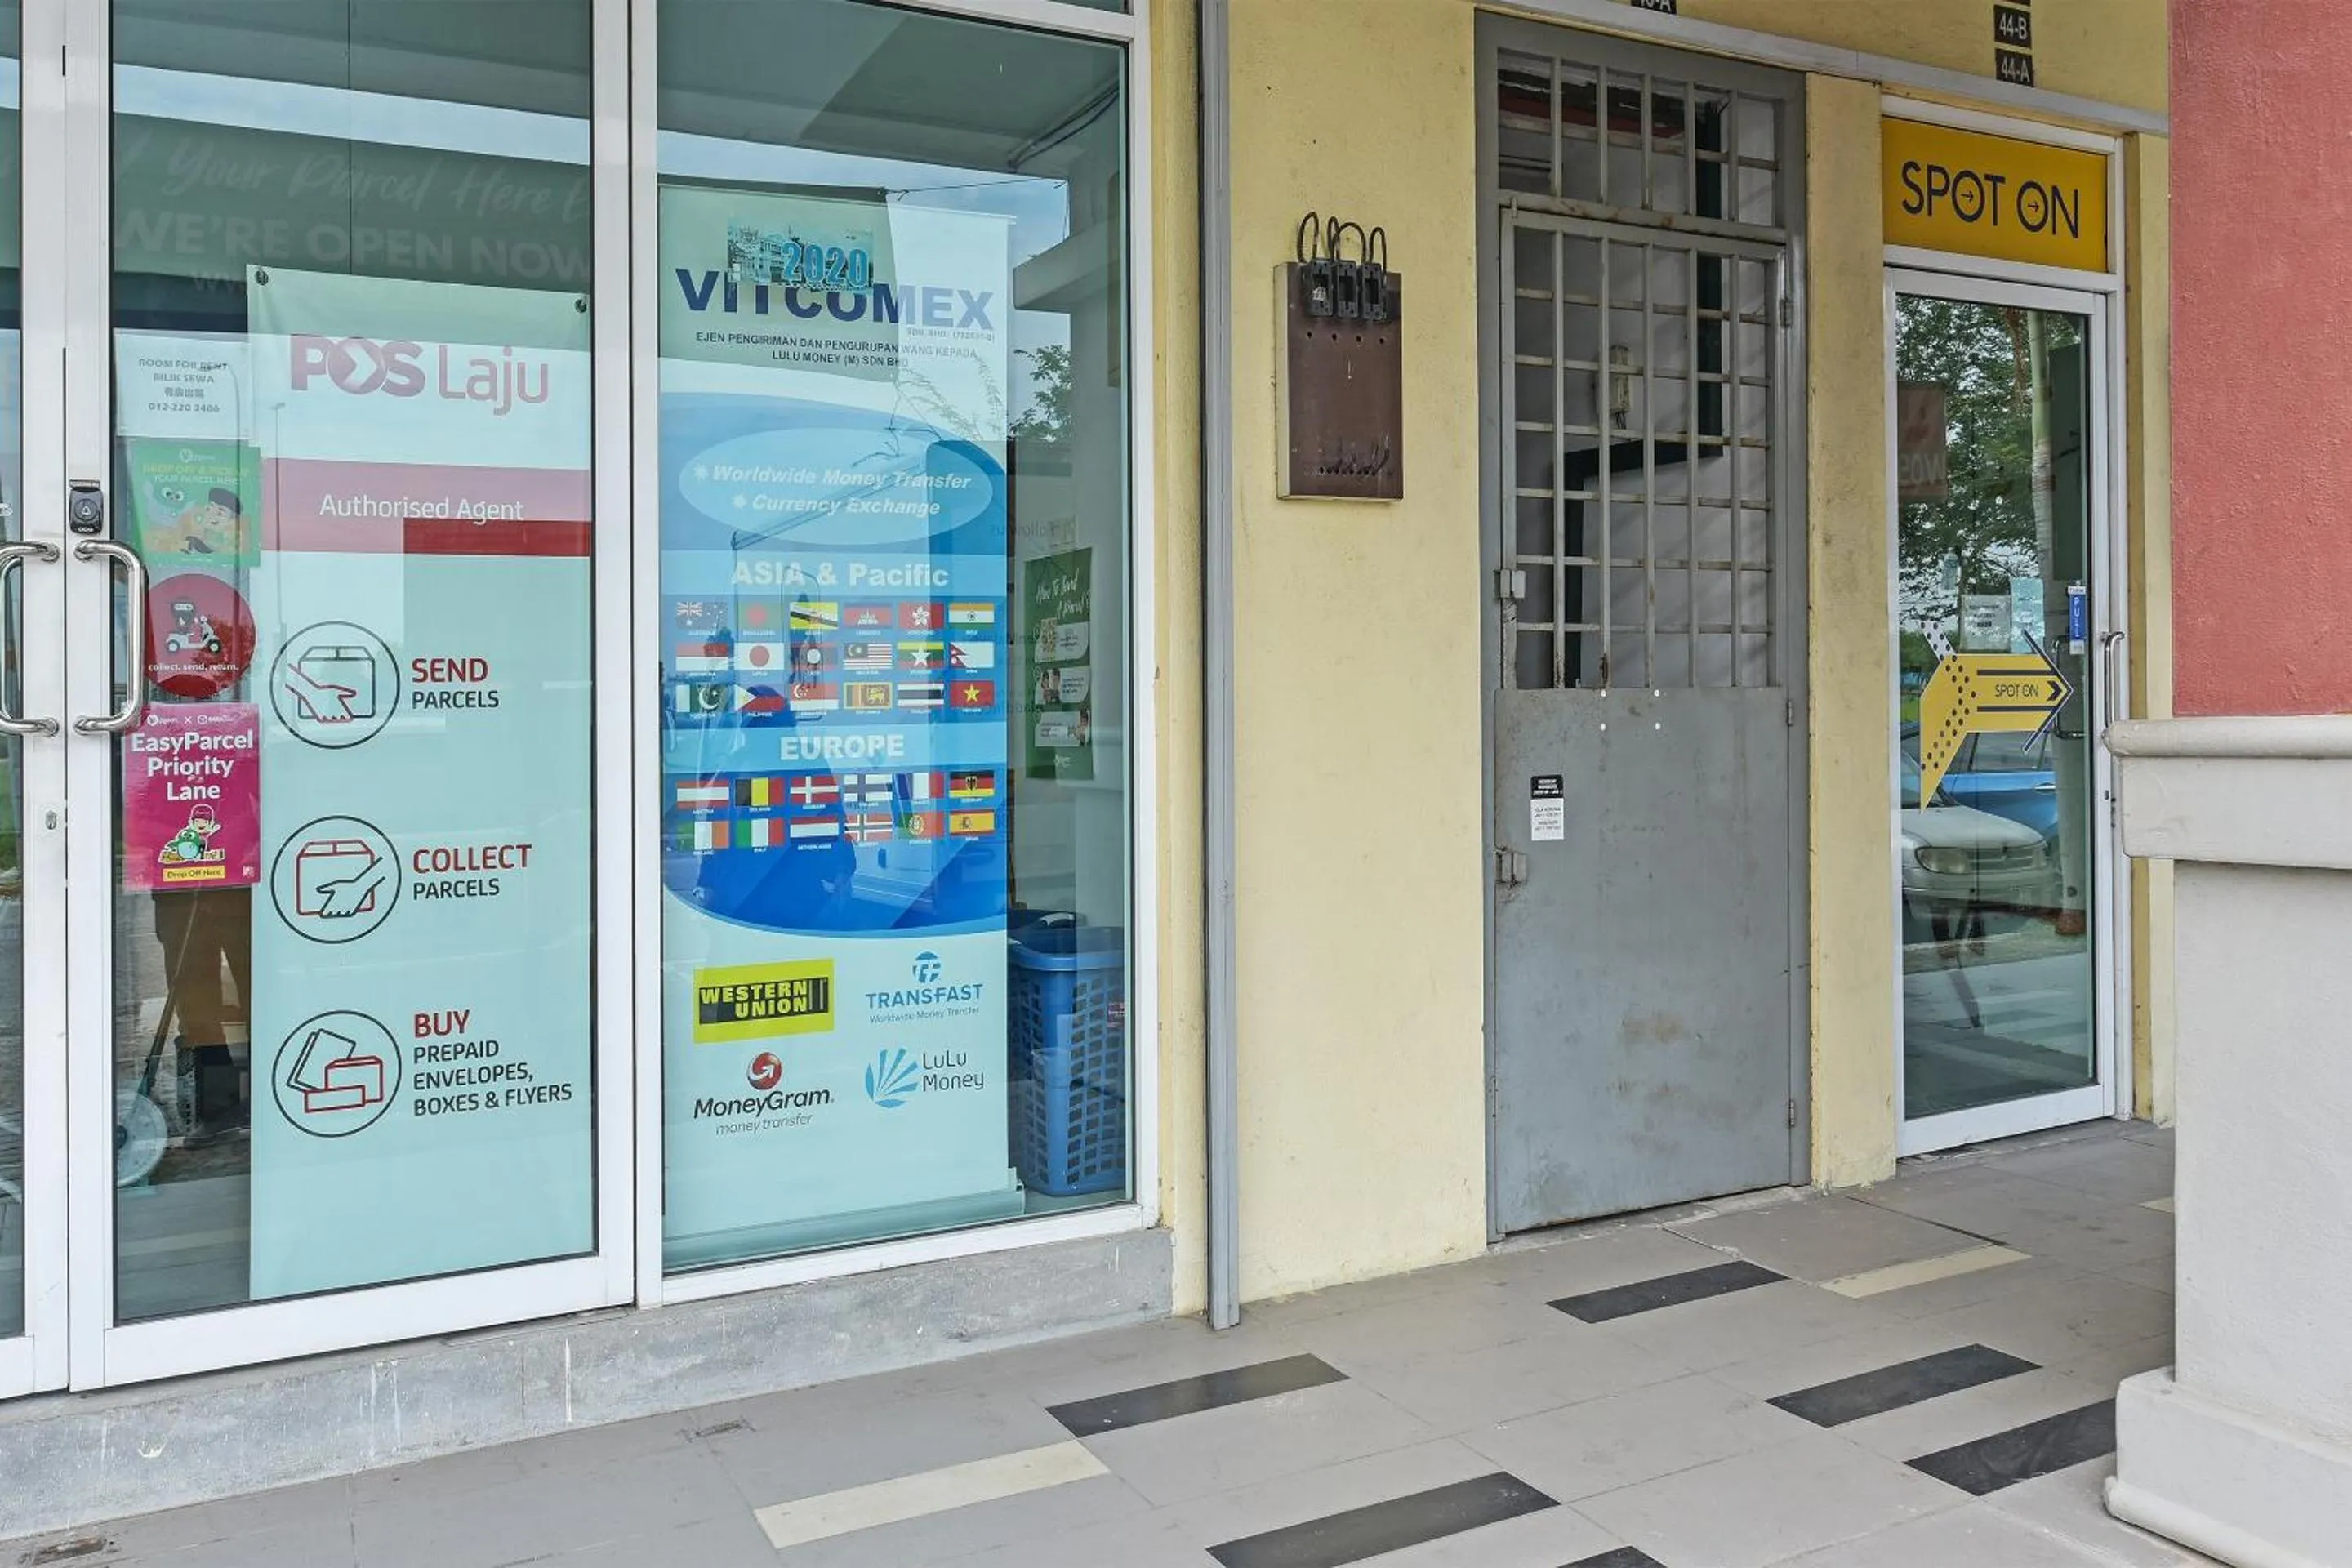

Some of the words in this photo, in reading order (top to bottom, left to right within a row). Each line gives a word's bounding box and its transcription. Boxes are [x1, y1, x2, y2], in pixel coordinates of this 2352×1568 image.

[1999, 12, 2028, 40] 44-B
[2001, 56, 2030, 82] 44-A
[1901, 161, 2006, 227] SPOT
[2016, 180, 2078, 239] ON
[307, 222, 455, 273] OPEN
[470, 235, 589, 283] NOW
[780, 239, 871, 287] 2020
[697, 332, 725, 343] EJEN
[728, 334, 798, 347] PENGIRIMAN
[800, 337, 822, 349] DAN
[825, 340, 898, 354] PENGURUPAN
[139, 359, 173, 368] ROOM
[772, 350, 800, 362] LULU
[802, 352, 841, 364] MONEY
[862, 355, 884, 366] SDN
[439, 344, 548, 416] Laju
[713, 465, 816, 484] Worldwide
[822, 468, 887, 490] Money
[894, 470, 972, 490] Transfer
[320, 494, 449, 519] Authorised
[456, 497, 525, 525] Agent
[752, 494, 841, 516] Currency
[845, 497, 941, 519] Exchange
[730, 560, 805, 586] ASIA
[815, 562, 839, 586] &
[849, 562, 950, 587] Pacific
[412, 657, 488, 683] SEND
[412, 690, 500, 710] PARCELS
[1994, 684, 2020, 698] SPOT
[2022, 684, 2039, 697] ON
[131, 728, 254, 754] EasyParcel
[780, 733, 905, 760] EUROPE
[147, 755, 234, 777] Priority
[167, 782, 221, 801] Lane
[412, 843, 532, 874] COLLECT
[412, 878, 501, 901] PARCELS
[699, 980, 808, 1004] WESTERN
[865, 983, 984, 1009] TRANSFAST
[734, 999, 808, 1018] UNION
[414, 1009, 470, 1039] BUY
[413, 1040, 500, 1064] PREPAID
[413, 1062, 534, 1091] ENVELOPES,
[922, 1070, 984, 1093] Money
[413, 1094, 479, 1117] BOXES
[484, 1090, 501, 1109] &
[505, 1083, 572, 1107] FLYERS
[693, 1089, 831, 1120] MoneyGram
[715, 1119, 760, 1136] money
[762, 1112, 814, 1132] transfer
